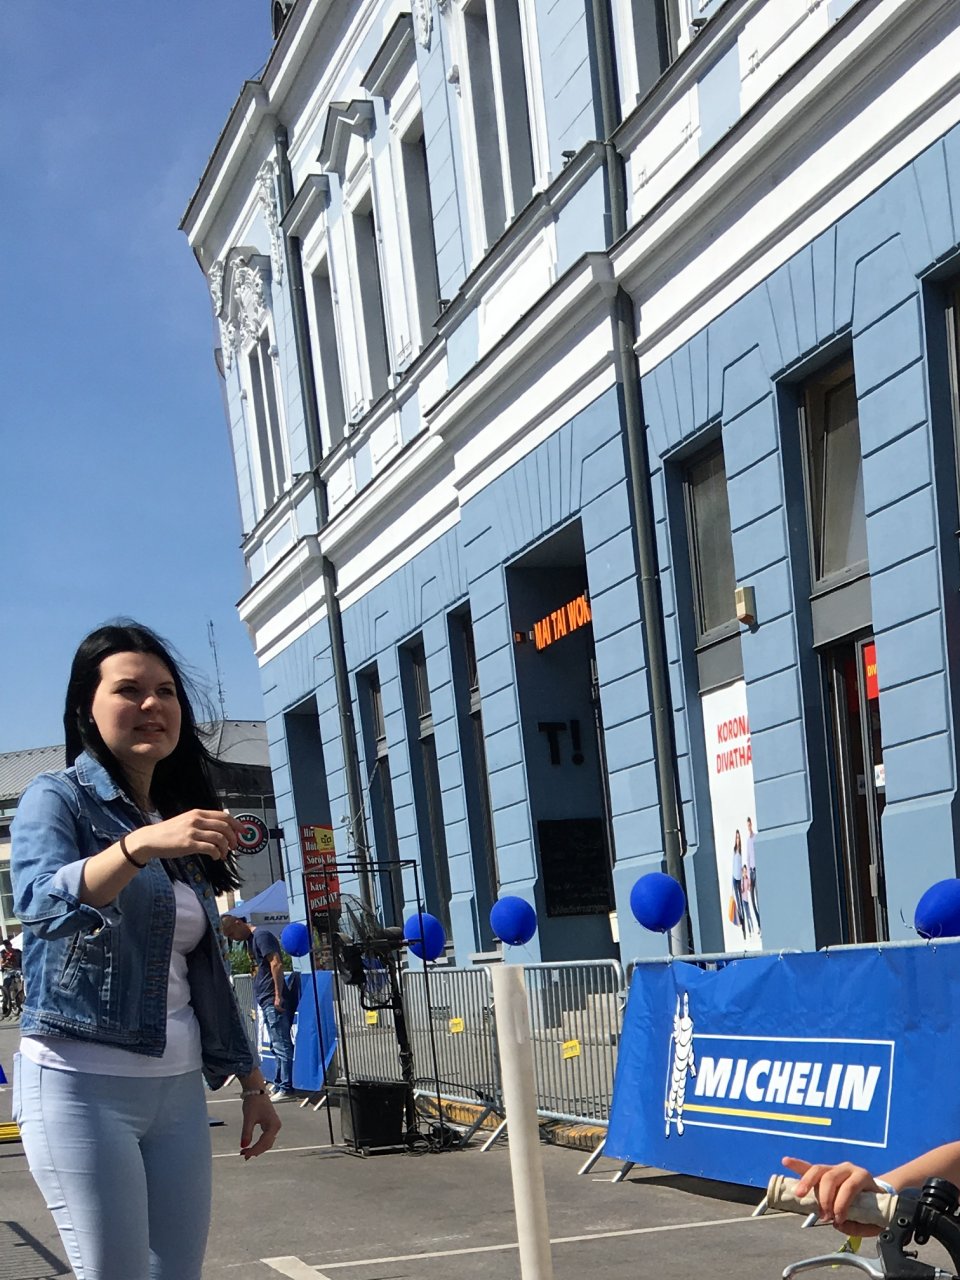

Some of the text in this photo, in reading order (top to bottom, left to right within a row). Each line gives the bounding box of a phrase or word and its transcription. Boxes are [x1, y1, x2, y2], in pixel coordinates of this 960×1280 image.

[550, 606, 567, 641] TAI
[566, 594, 592, 632] WOK
[694, 1056, 882, 1112] MICHELIN
